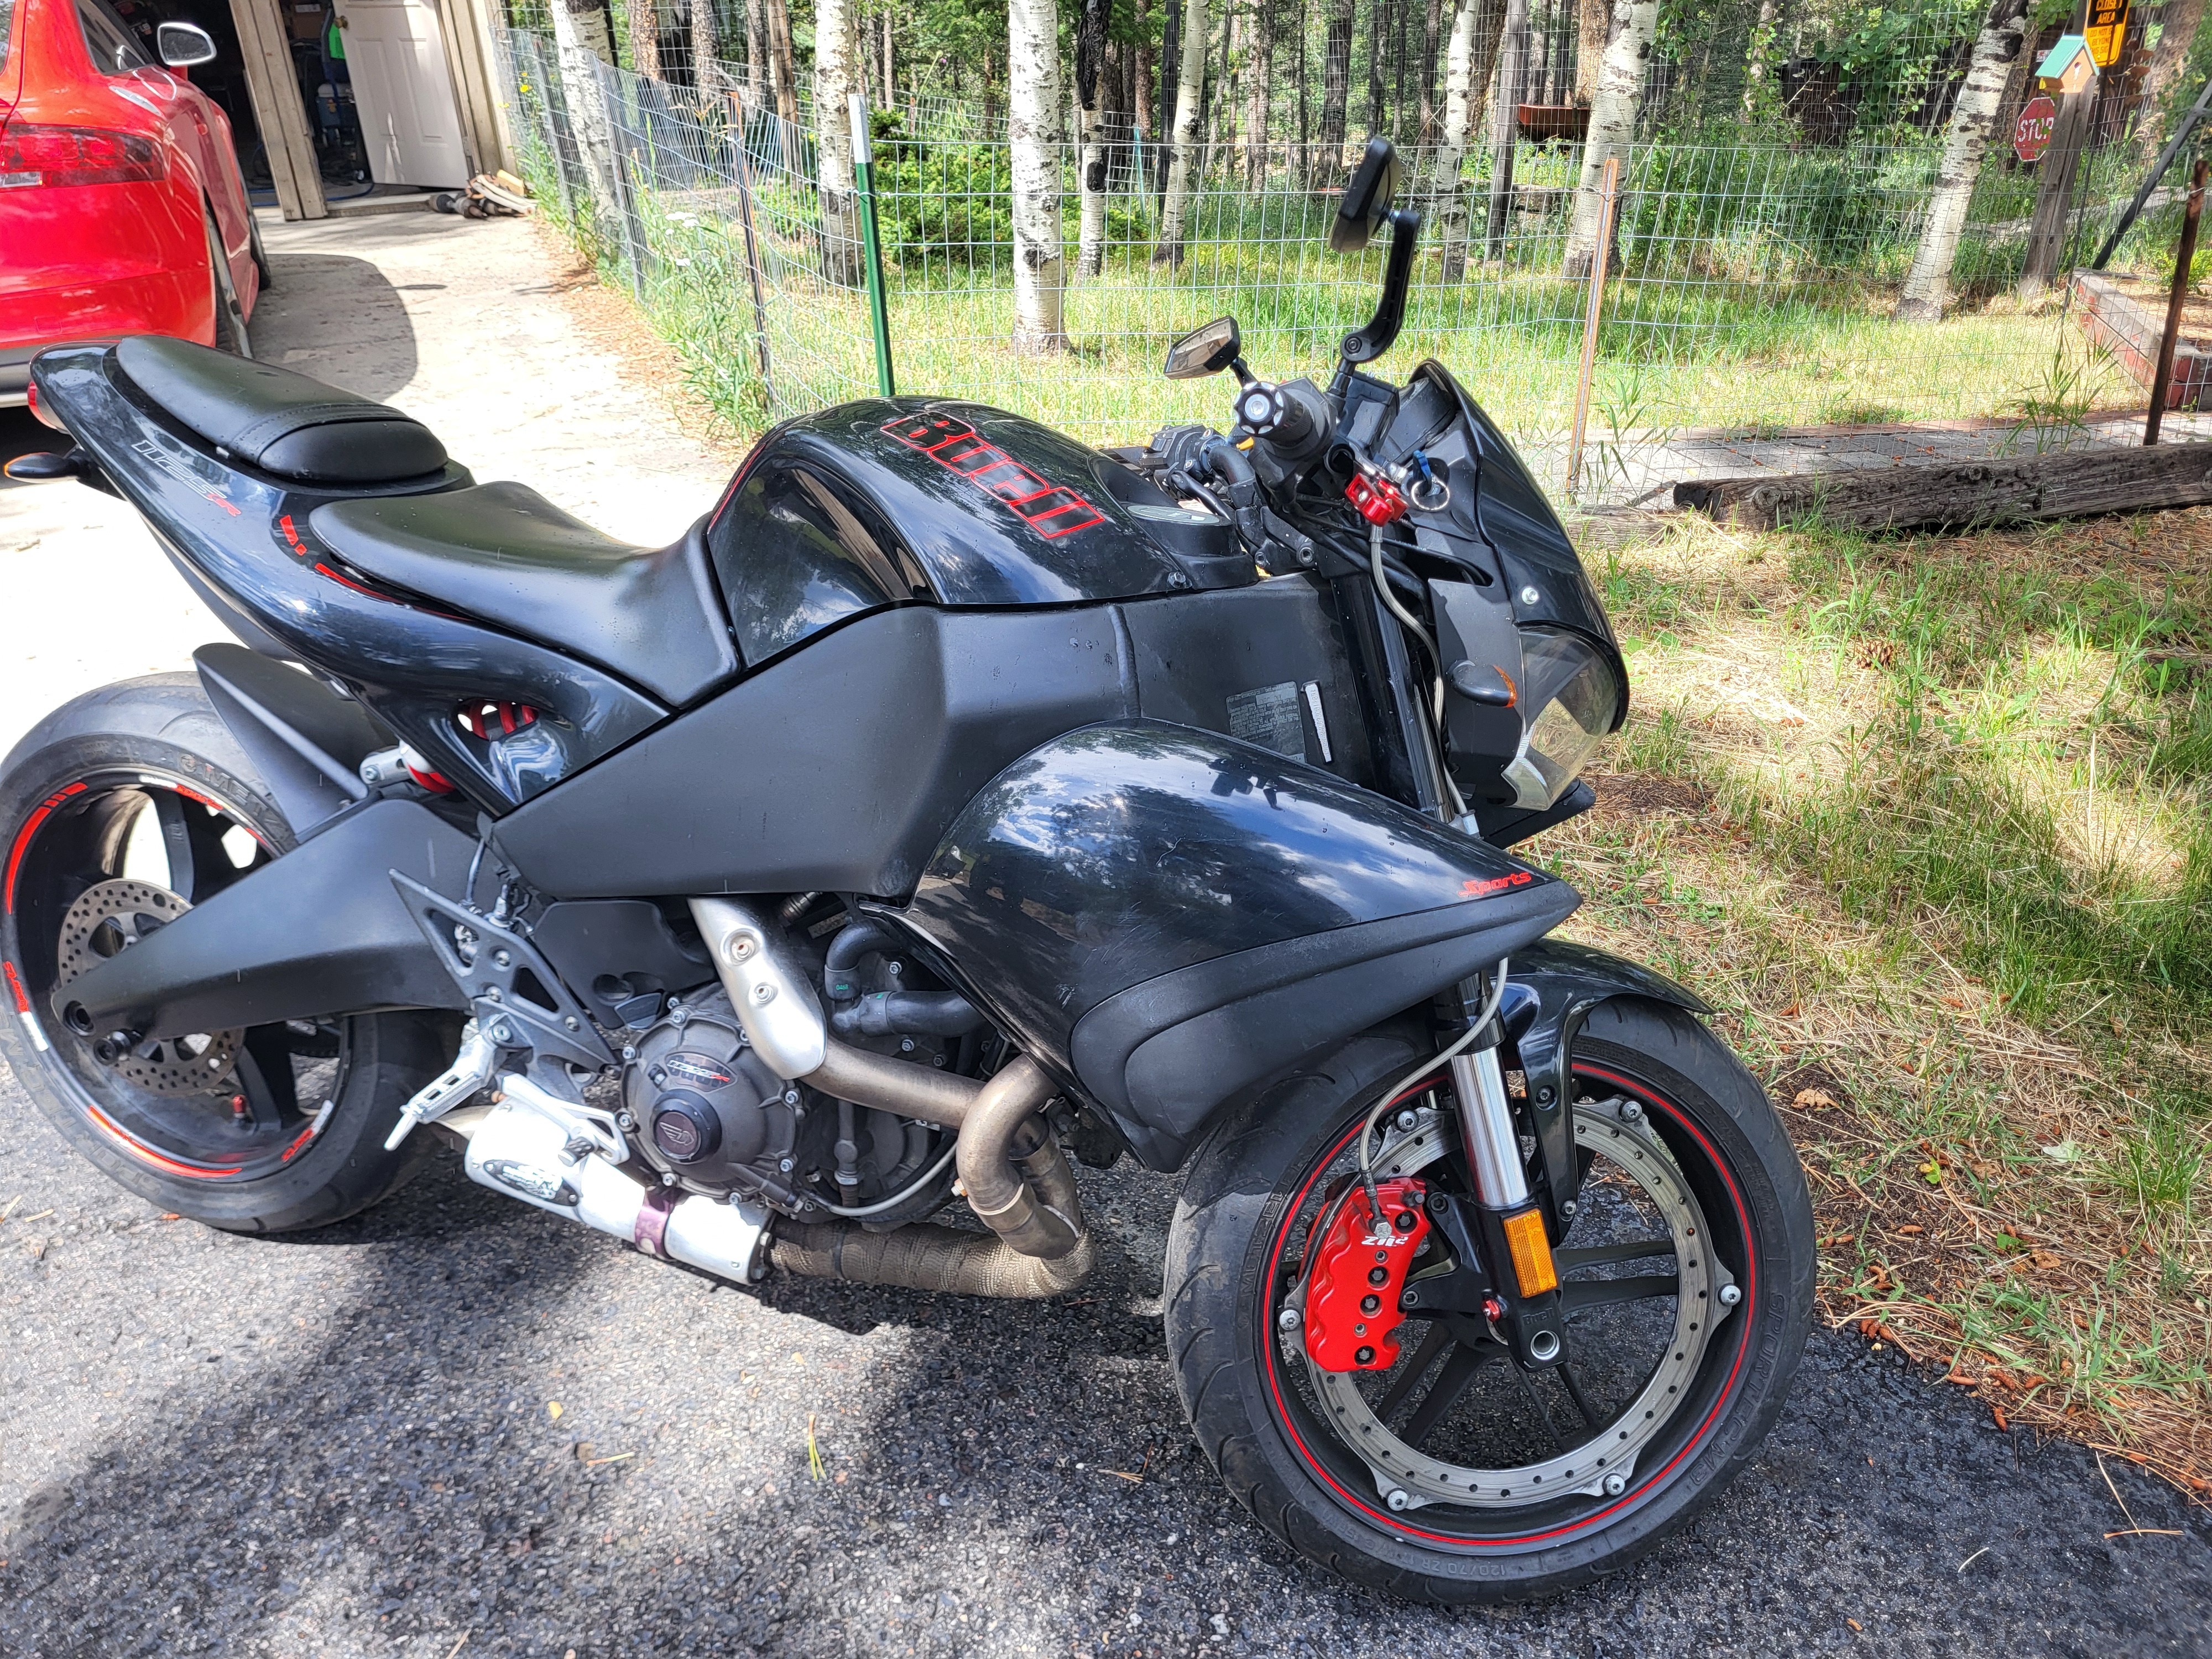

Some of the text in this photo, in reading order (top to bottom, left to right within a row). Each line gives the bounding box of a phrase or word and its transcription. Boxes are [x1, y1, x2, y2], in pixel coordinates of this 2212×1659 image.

[2096, 11, 2115, 24] AREA
[2018, 117, 2054, 142] STOP
[1458, 872, 1532, 895] Sports
[1725, 1292, 1785, 1439] SPORTEC
[1447, 1563, 1506, 1576] 120/70
